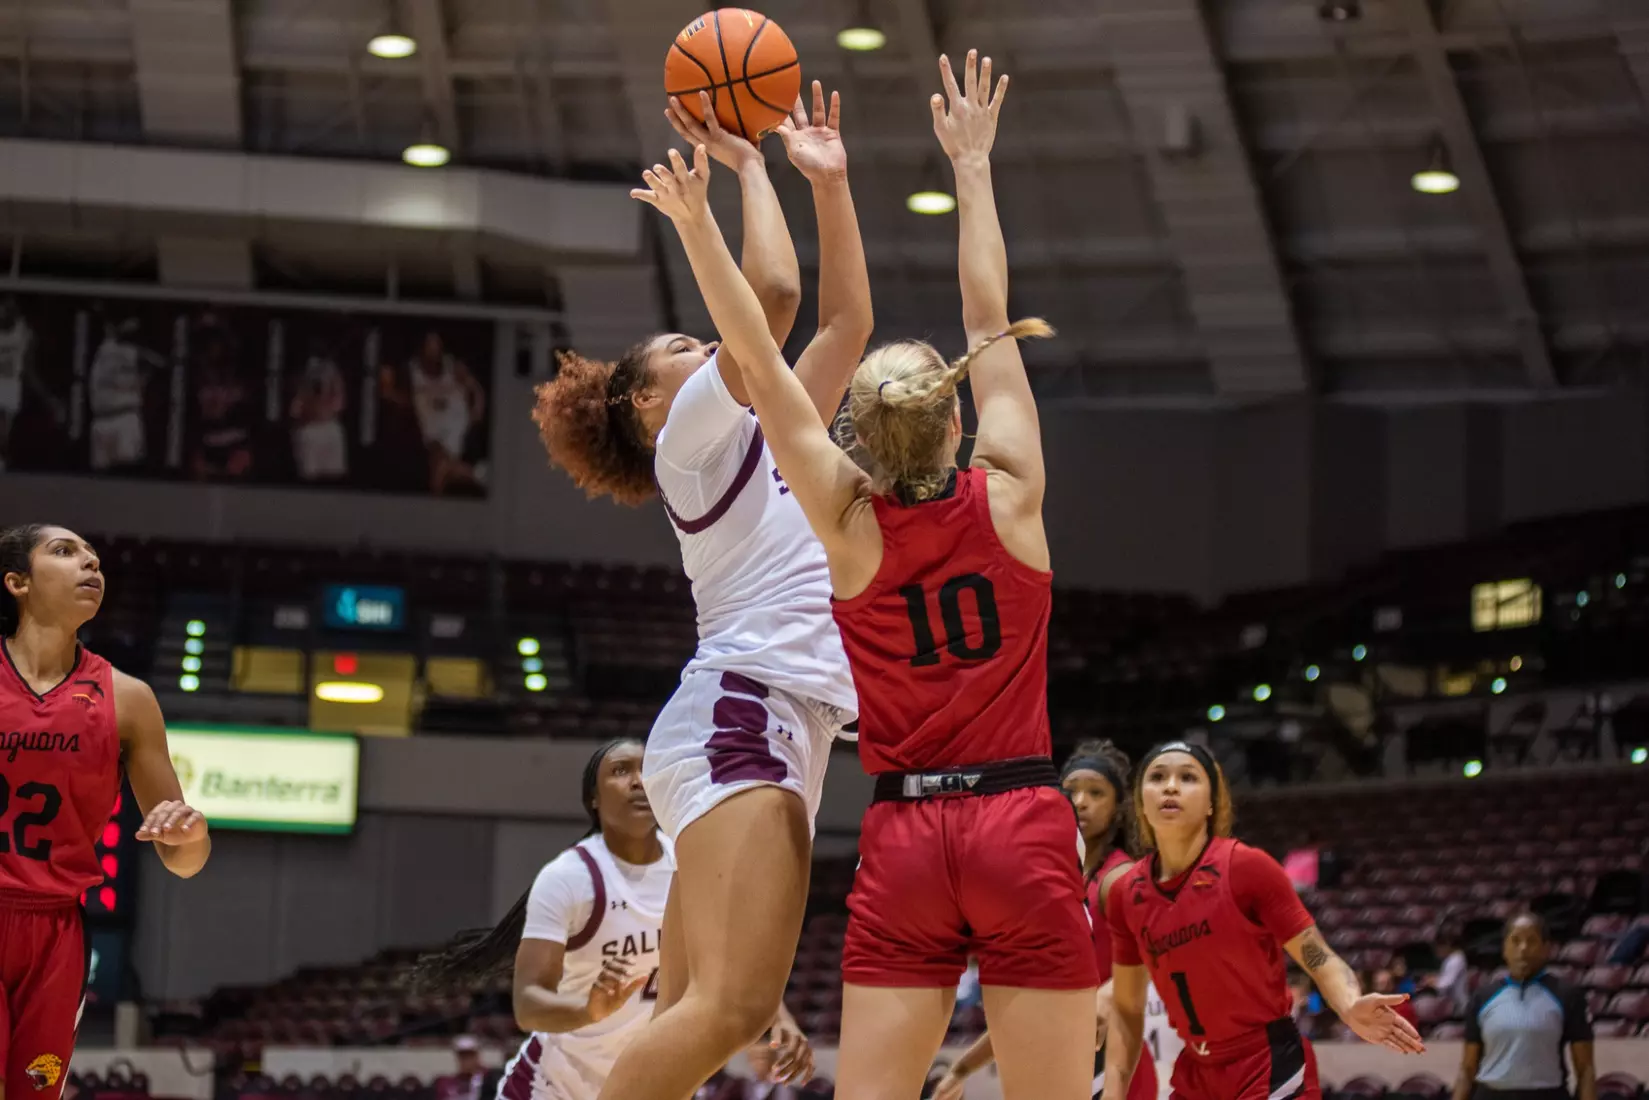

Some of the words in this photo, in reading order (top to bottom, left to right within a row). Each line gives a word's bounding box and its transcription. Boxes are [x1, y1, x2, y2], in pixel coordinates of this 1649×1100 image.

[899, 572, 1002, 667] 10
[0, 773, 62, 861] 2
[1170, 971, 1206, 1036] 1
